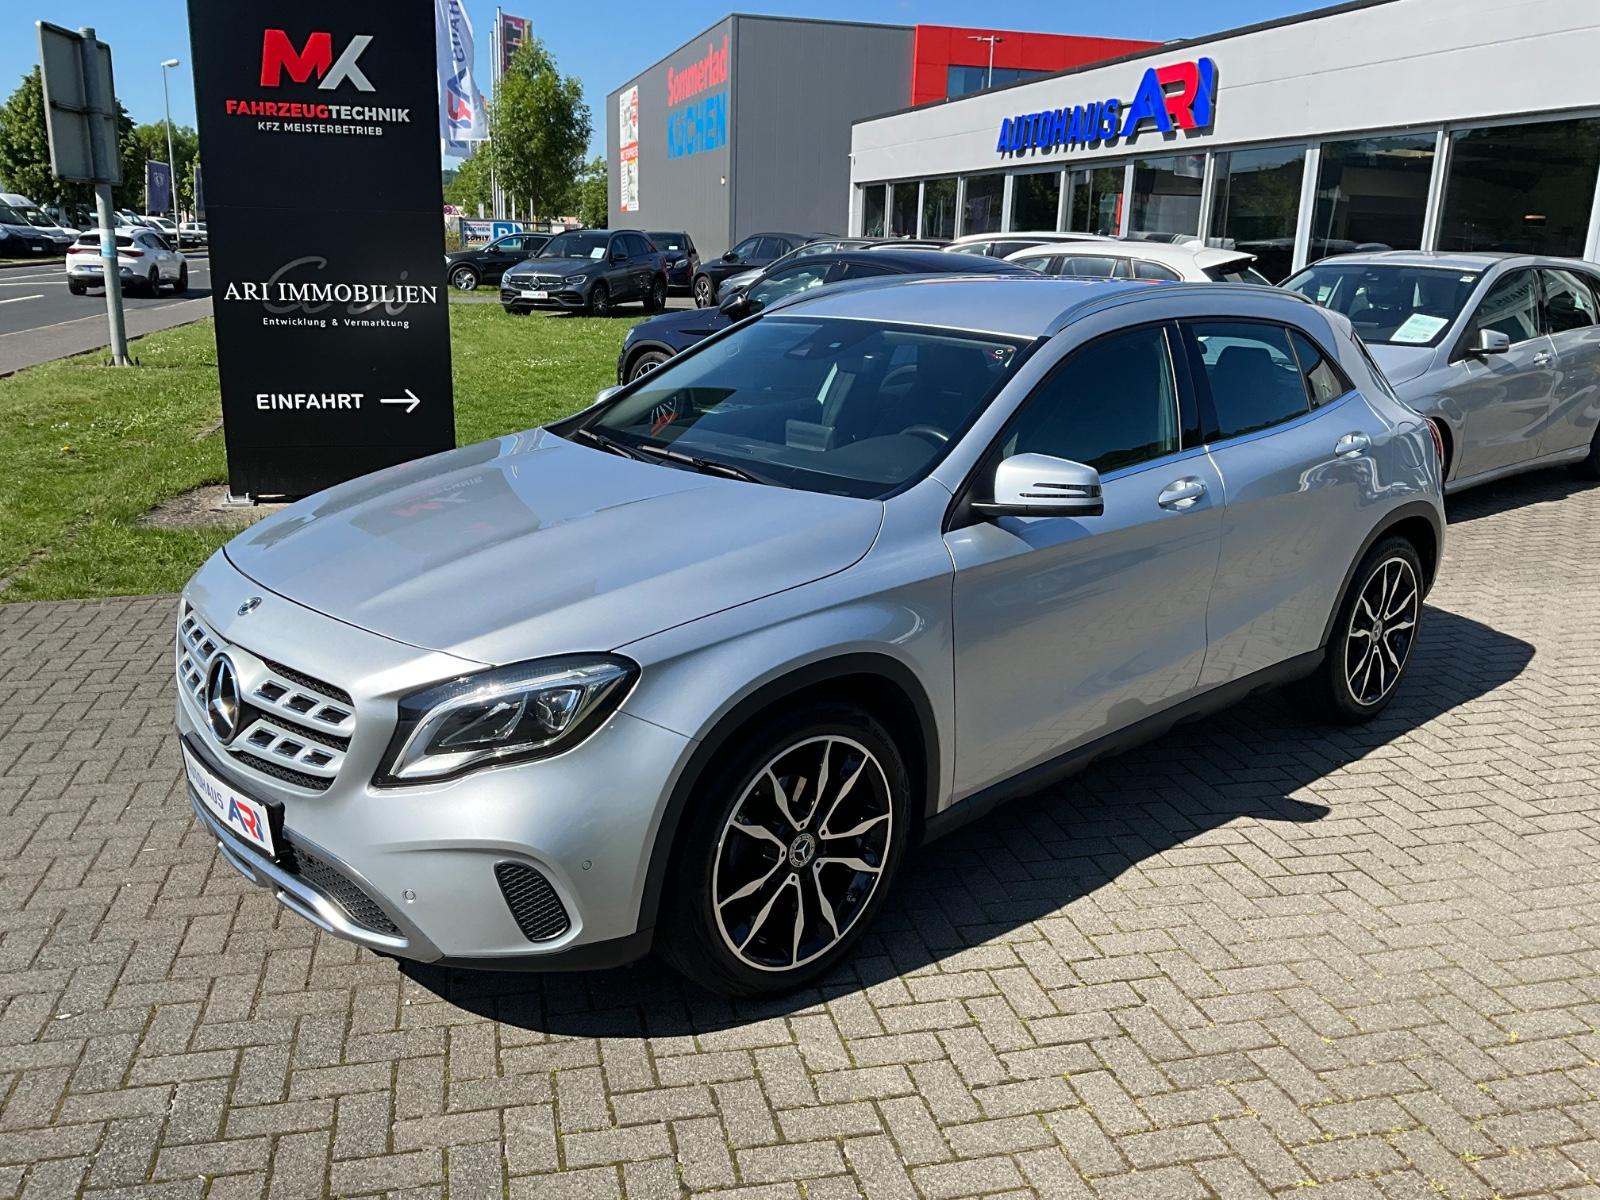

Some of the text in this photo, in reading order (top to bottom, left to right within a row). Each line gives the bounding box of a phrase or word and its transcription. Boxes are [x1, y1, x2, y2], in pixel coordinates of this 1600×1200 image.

[260, 29, 377, 92] MK
[667, 34, 730, 107] Sommerlad
[225, 100, 411, 123] FAHRZEUGTECHNIK
[996, 57, 1217, 154] AUTOHAUS ARI
[257, 121, 383, 136] KFZ MEISTERBETRIEB
[667, 92, 729, 161] KÜCHEN
[223, 282, 438, 304] ARI IMMOBILIEN
[262, 317, 410, 329] Entwicklung & Vermarktung
[255, 393, 364, 410] EINFAHRT
[228, 796, 265, 843] ARI
